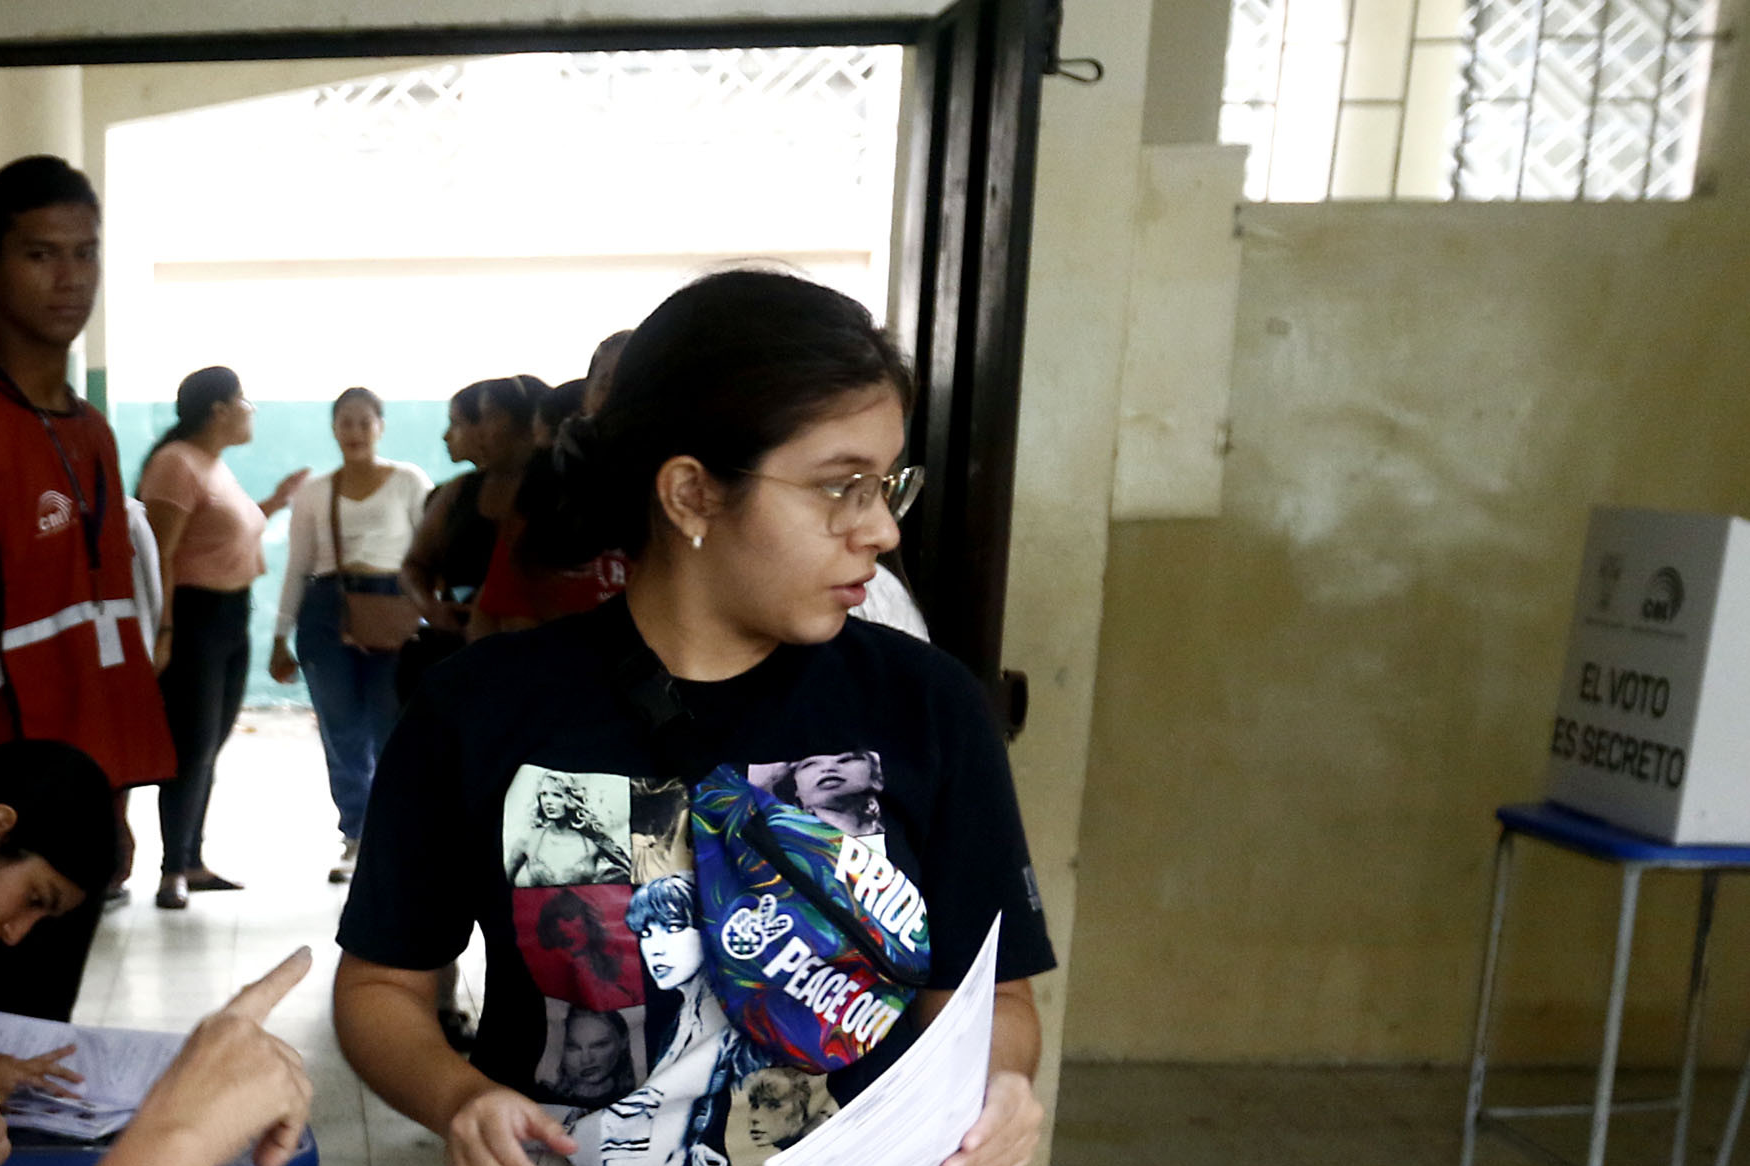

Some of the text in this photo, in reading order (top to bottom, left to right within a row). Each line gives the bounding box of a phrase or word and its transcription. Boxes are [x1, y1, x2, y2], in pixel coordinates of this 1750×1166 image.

[1580, 661, 1671, 719] EL VOTO
[1552, 716, 1685, 788] ES SECRETO
[834, 834, 928, 952] PRIDE
[762, 936, 902, 1048] PEACE OUT
